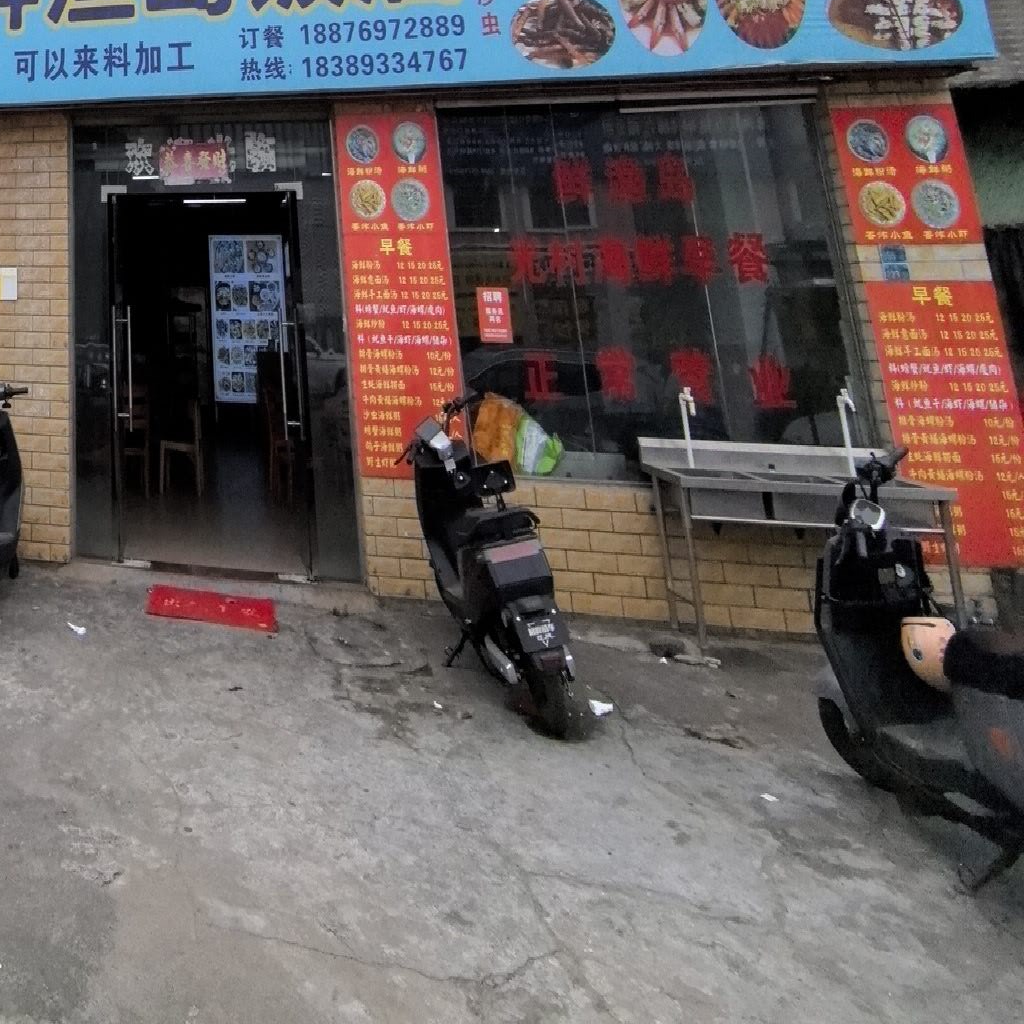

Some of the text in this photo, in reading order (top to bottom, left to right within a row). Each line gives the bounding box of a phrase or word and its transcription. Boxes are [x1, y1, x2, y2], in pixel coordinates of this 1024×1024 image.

[239, 14, 465, 51] 订餐 18876972889
[14, 40, 195, 83] 可以来料加工
[300, 47, 469, 79] 18389334767
[380, 238, 413, 256] 早餐
[912, 286, 953, 305] 早餐
